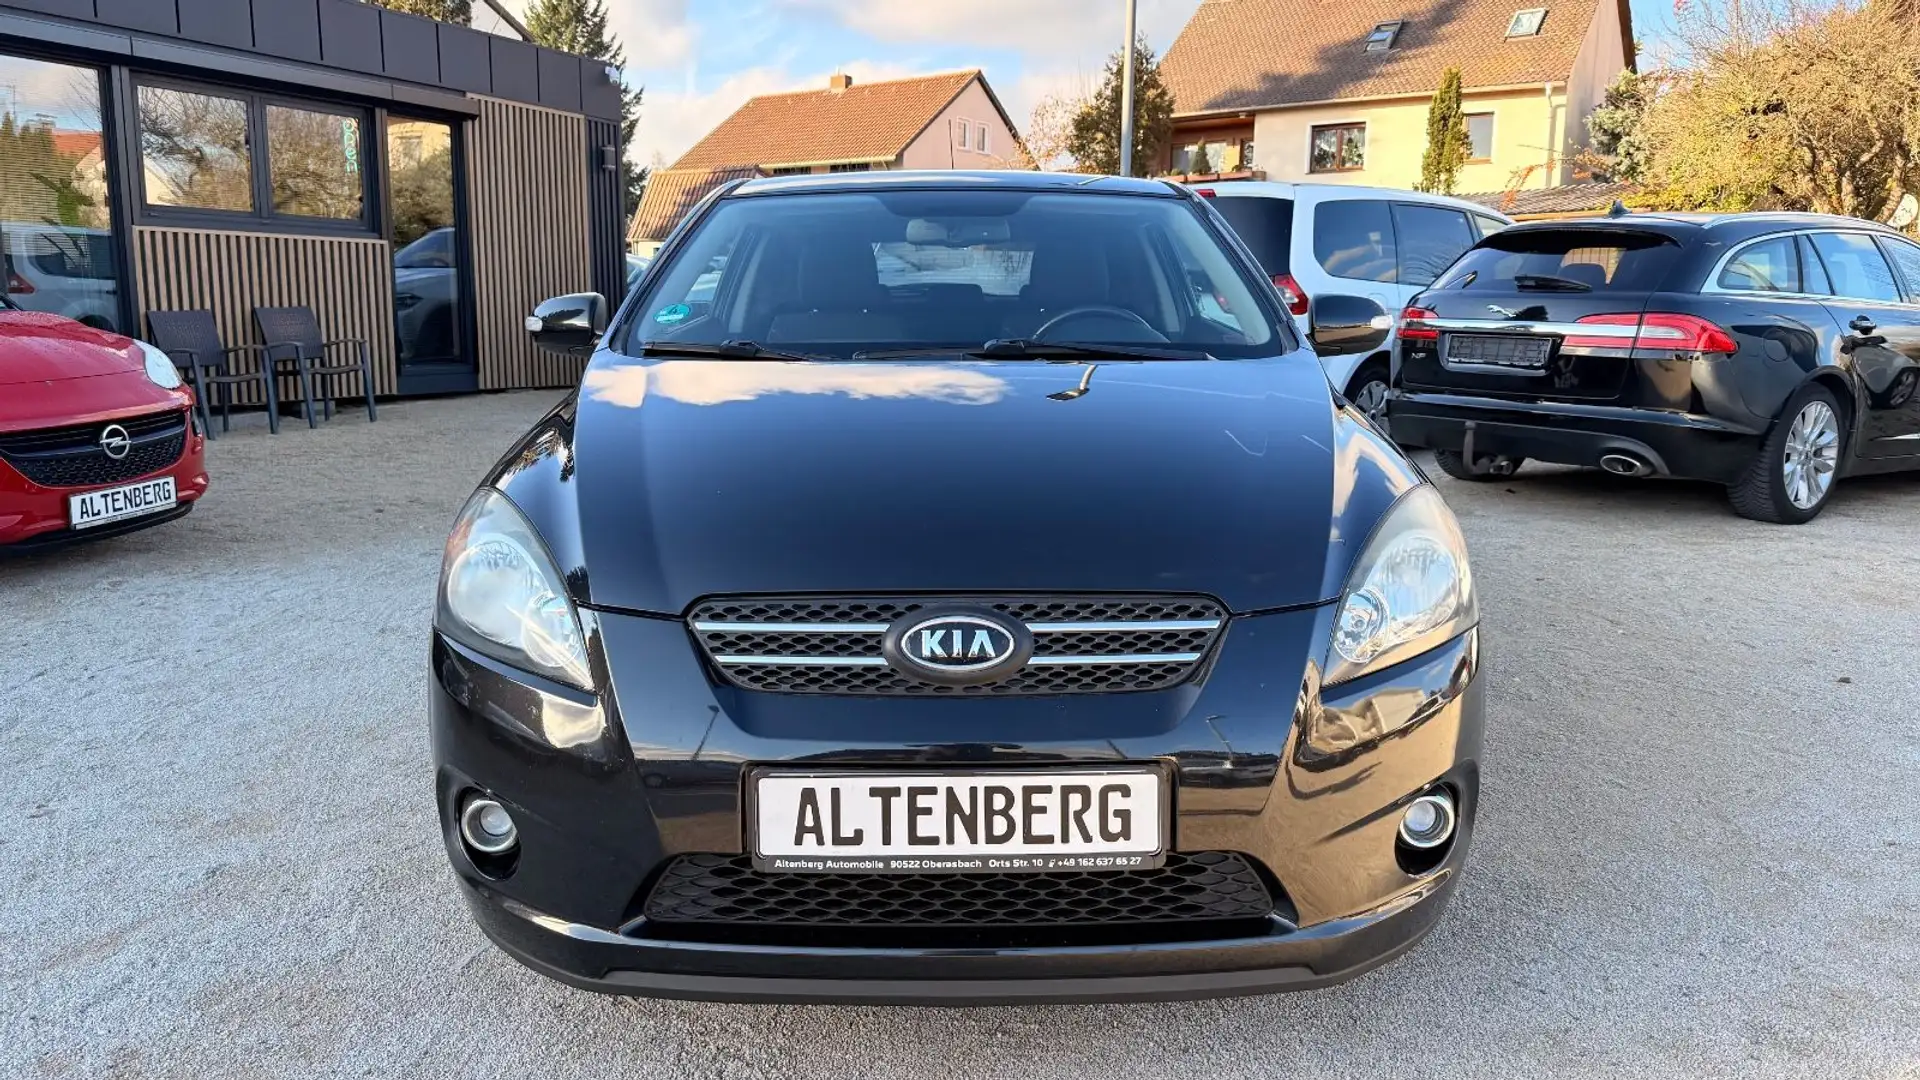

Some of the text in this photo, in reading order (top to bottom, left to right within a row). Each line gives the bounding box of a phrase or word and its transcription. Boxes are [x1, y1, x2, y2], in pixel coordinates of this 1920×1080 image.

[343, 117, 358, 174] open
[79, 481, 172, 520] ALTENBERG
[920, 629, 996, 658] KIA
[794, 784, 1132, 847] ALTENBERG
[774, 857, 1142, 870] Altenberg Automobile 90522 Oberasbach Orts Str. 10 +49 162 637 65 27
